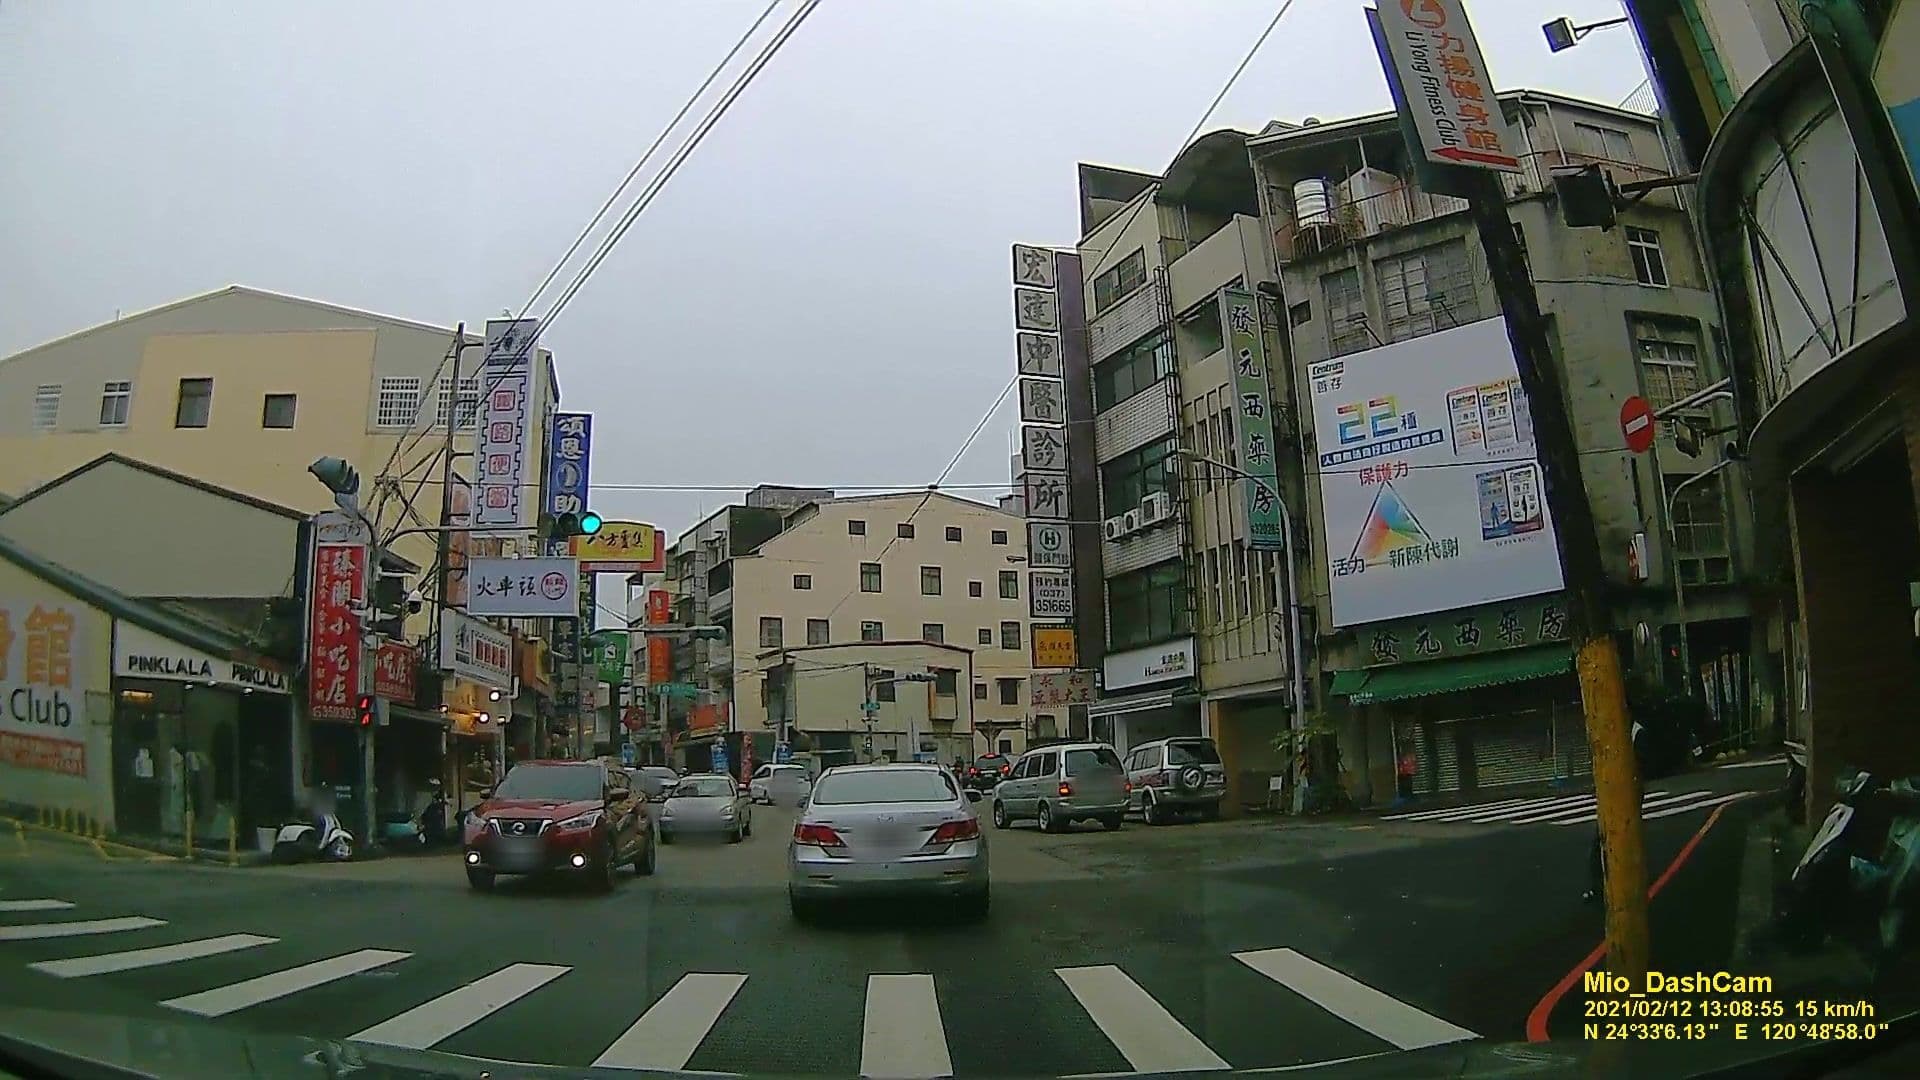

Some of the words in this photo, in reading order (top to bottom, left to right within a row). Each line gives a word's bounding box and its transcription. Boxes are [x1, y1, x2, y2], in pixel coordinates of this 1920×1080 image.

[1420, 74, 1447, 117] Fitness
[1435, 118, 1461, 146] Club
[1312, 361, 1344, 375] Centrum
[1022, 249, 1064, 517] 宏達中醫診所
[1359, 462, 1409, 486] 保護力
[1389, 538, 1459, 569] 新陳代謝
[1332, 556, 1365, 577] 活力
[476, 576, 537, 598] 火車頭
[129, 655, 214, 677] PINKLALA
[10, 688, 72, 728] Club
